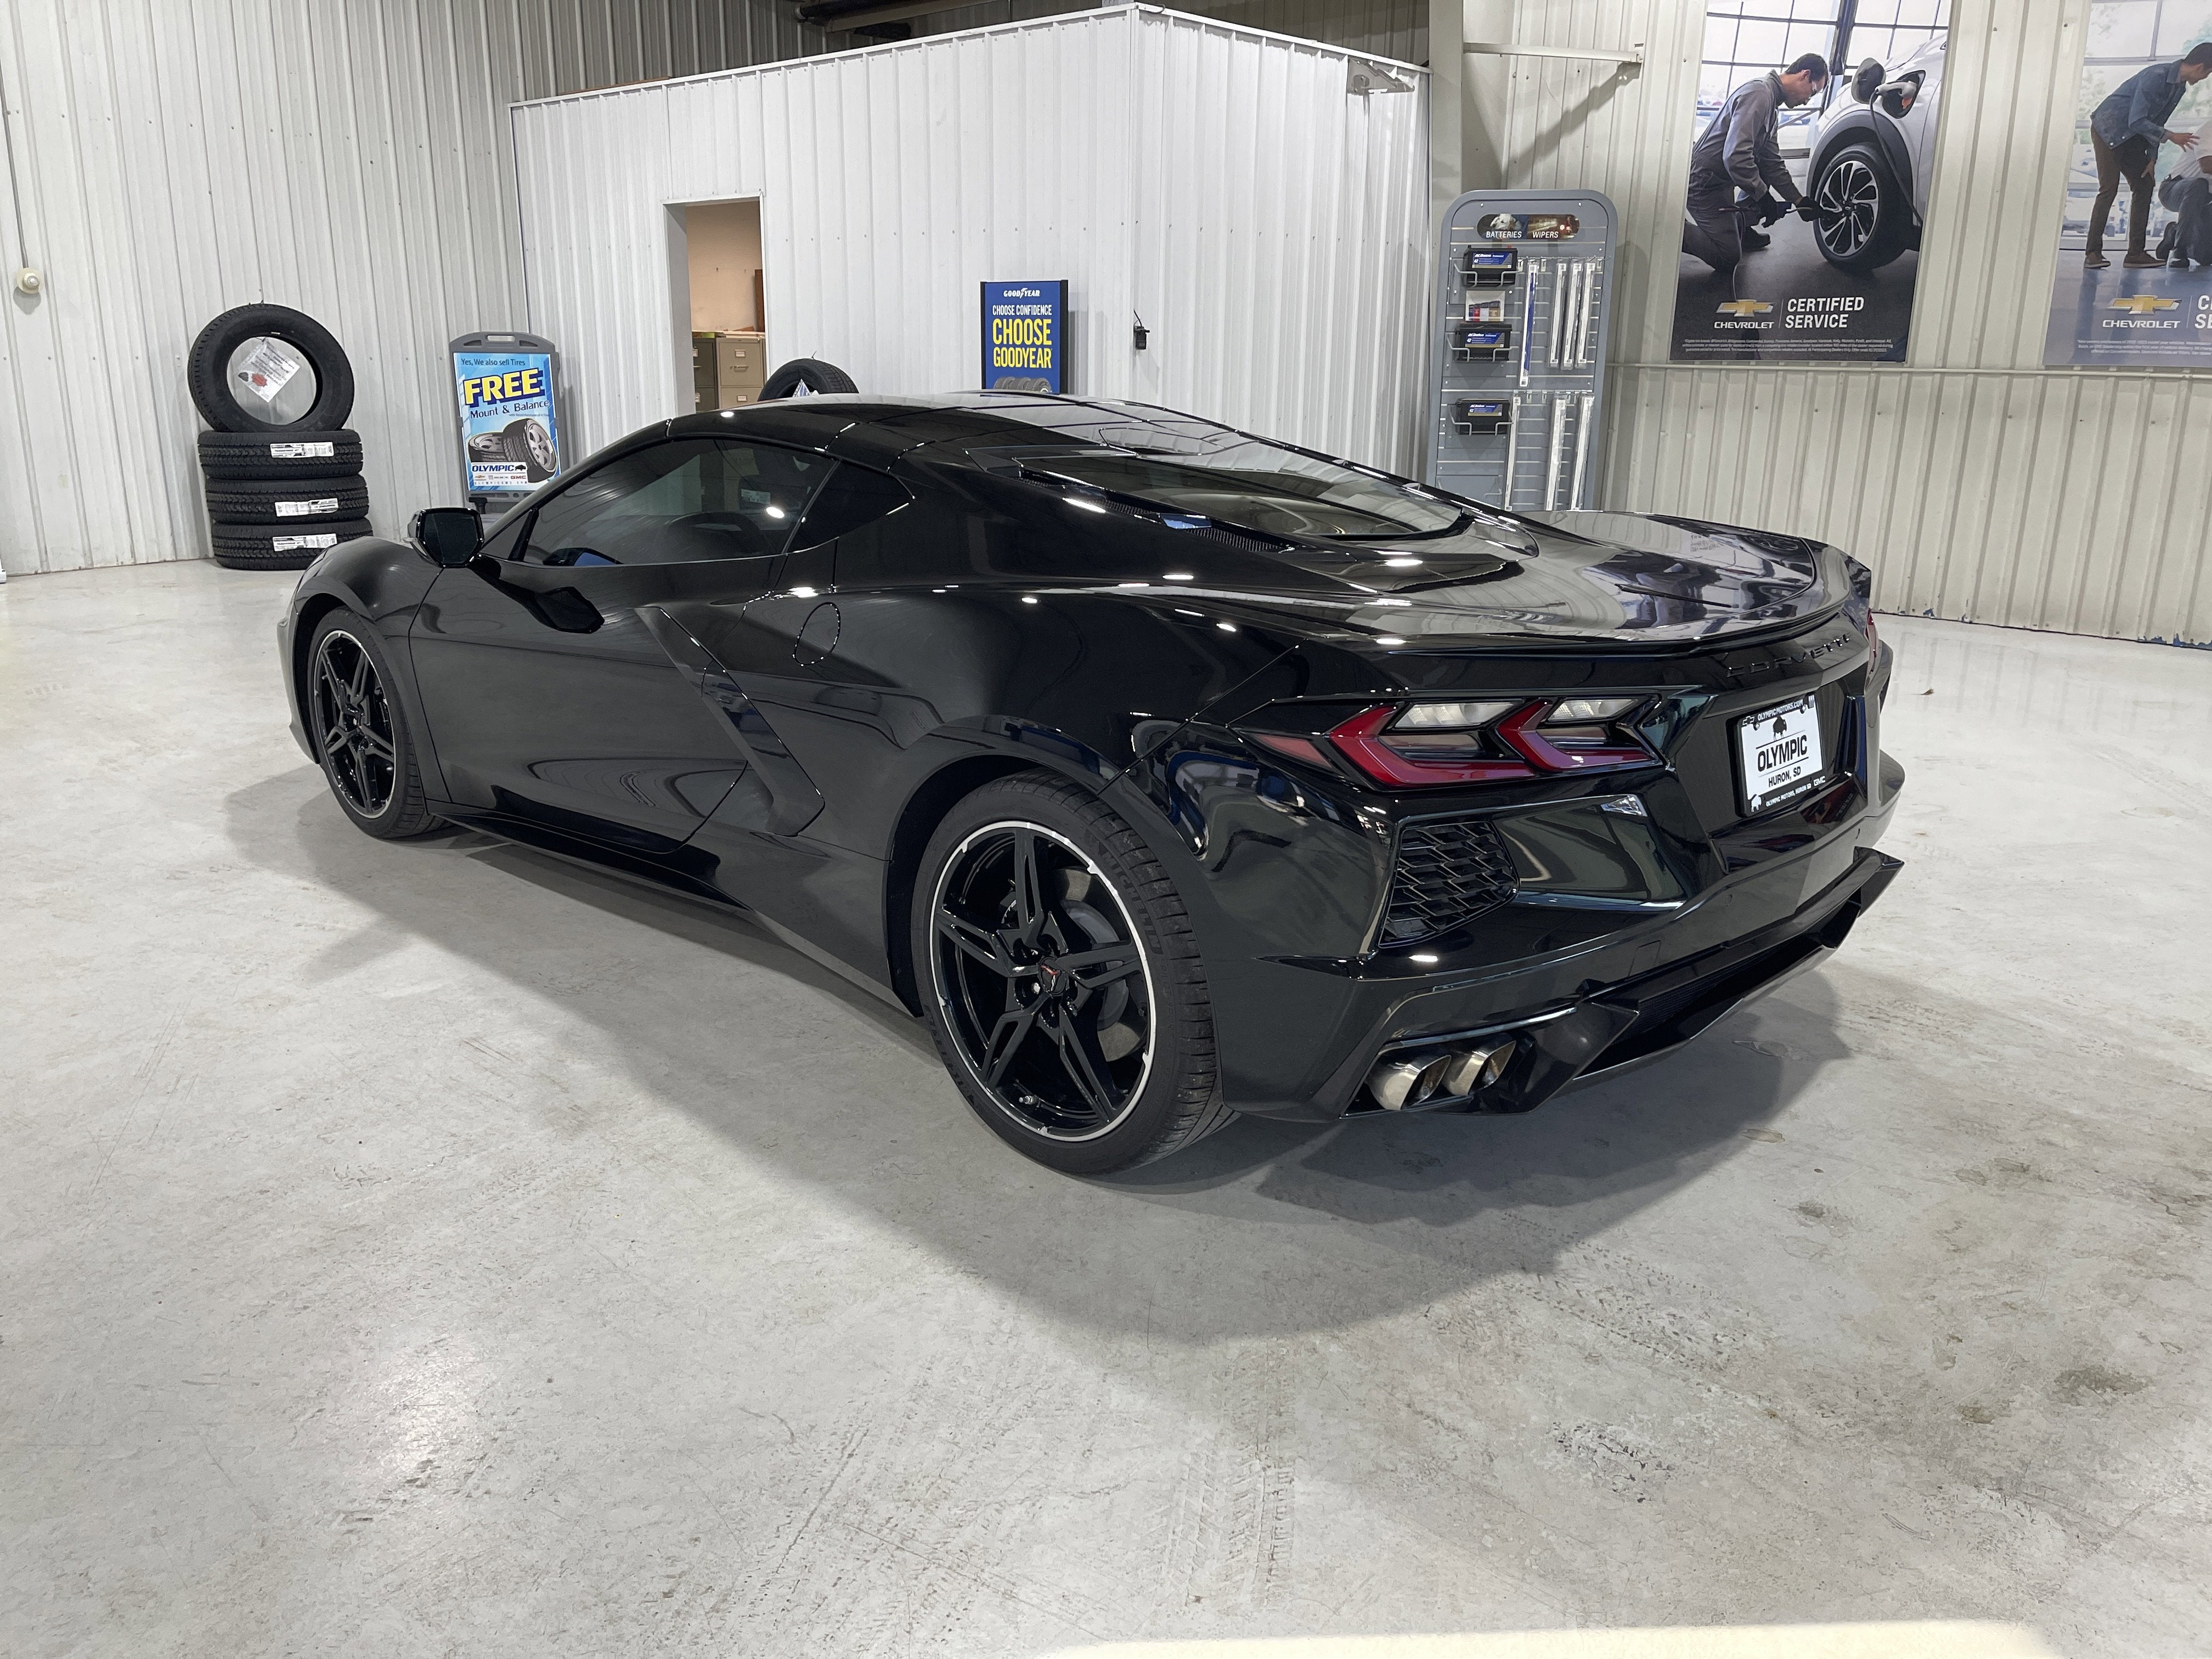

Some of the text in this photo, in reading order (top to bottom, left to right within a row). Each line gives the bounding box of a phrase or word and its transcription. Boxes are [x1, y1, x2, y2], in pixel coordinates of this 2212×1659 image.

[1003, 288, 1041, 298] GOODYEAR
[992, 304, 1052, 315] CHOOSE CONFIDENCE
[1787, 297, 1864, 312] CERTIFIED
[2198, 295, 2212, 311] C
[1785, 314, 1849, 329] SERVICE
[2102, 320, 2180, 329] CHEVROLET
[992, 318, 1052, 345] CHOOSE
[993, 347, 1052, 369] GOODYEAR
[464, 368, 541, 405] FREE
[470, 400, 550, 419] Mount & Balance
[1757, 735, 1808, 772] OLYMPIC
[1768, 766, 1801, 787] HURON, SD
[1101, 850, 1162, 949] MICHELIN
